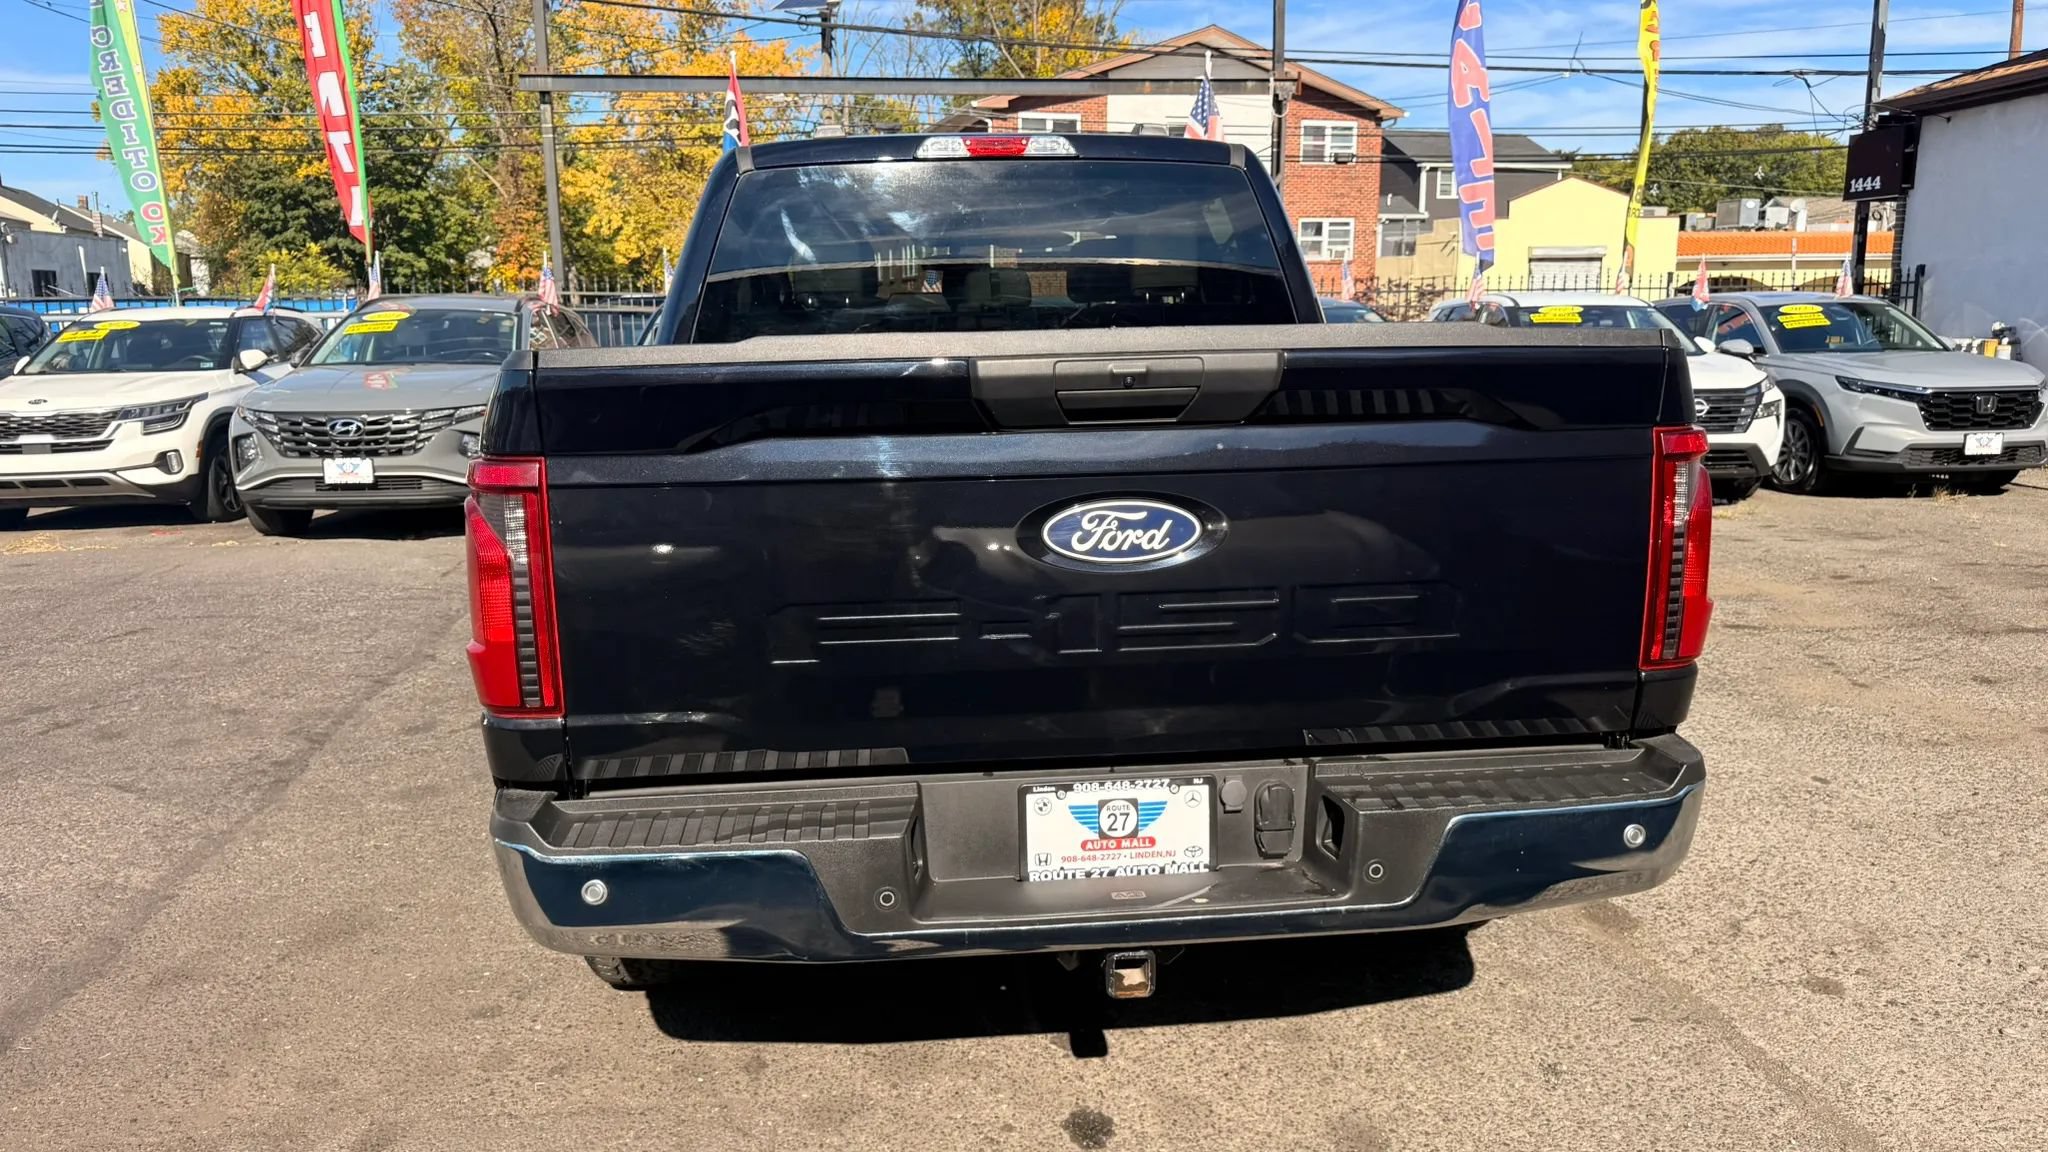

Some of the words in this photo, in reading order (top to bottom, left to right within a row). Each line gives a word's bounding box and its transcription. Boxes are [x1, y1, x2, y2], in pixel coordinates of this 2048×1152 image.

[1849, 176, 1881, 193] 1444
[1071, 510, 1173, 553] Ford
[1073, 779, 1170, 793] 908-648-2727
[1106, 804, 1131, 812] ROUTE
[1107, 812, 1130, 832] 27
[1086, 840, 1117, 850] AUTO
[1121, 837, 1152, 849] MALL
[1061, 853, 1121, 863] 908-648-2727
[1029, 868, 1086, 882] ROUTE
[1090, 866, 1110, 878] 27
[1114, 864, 1160, 877] AUTO
[1164, 860, 1209, 875] MALL
